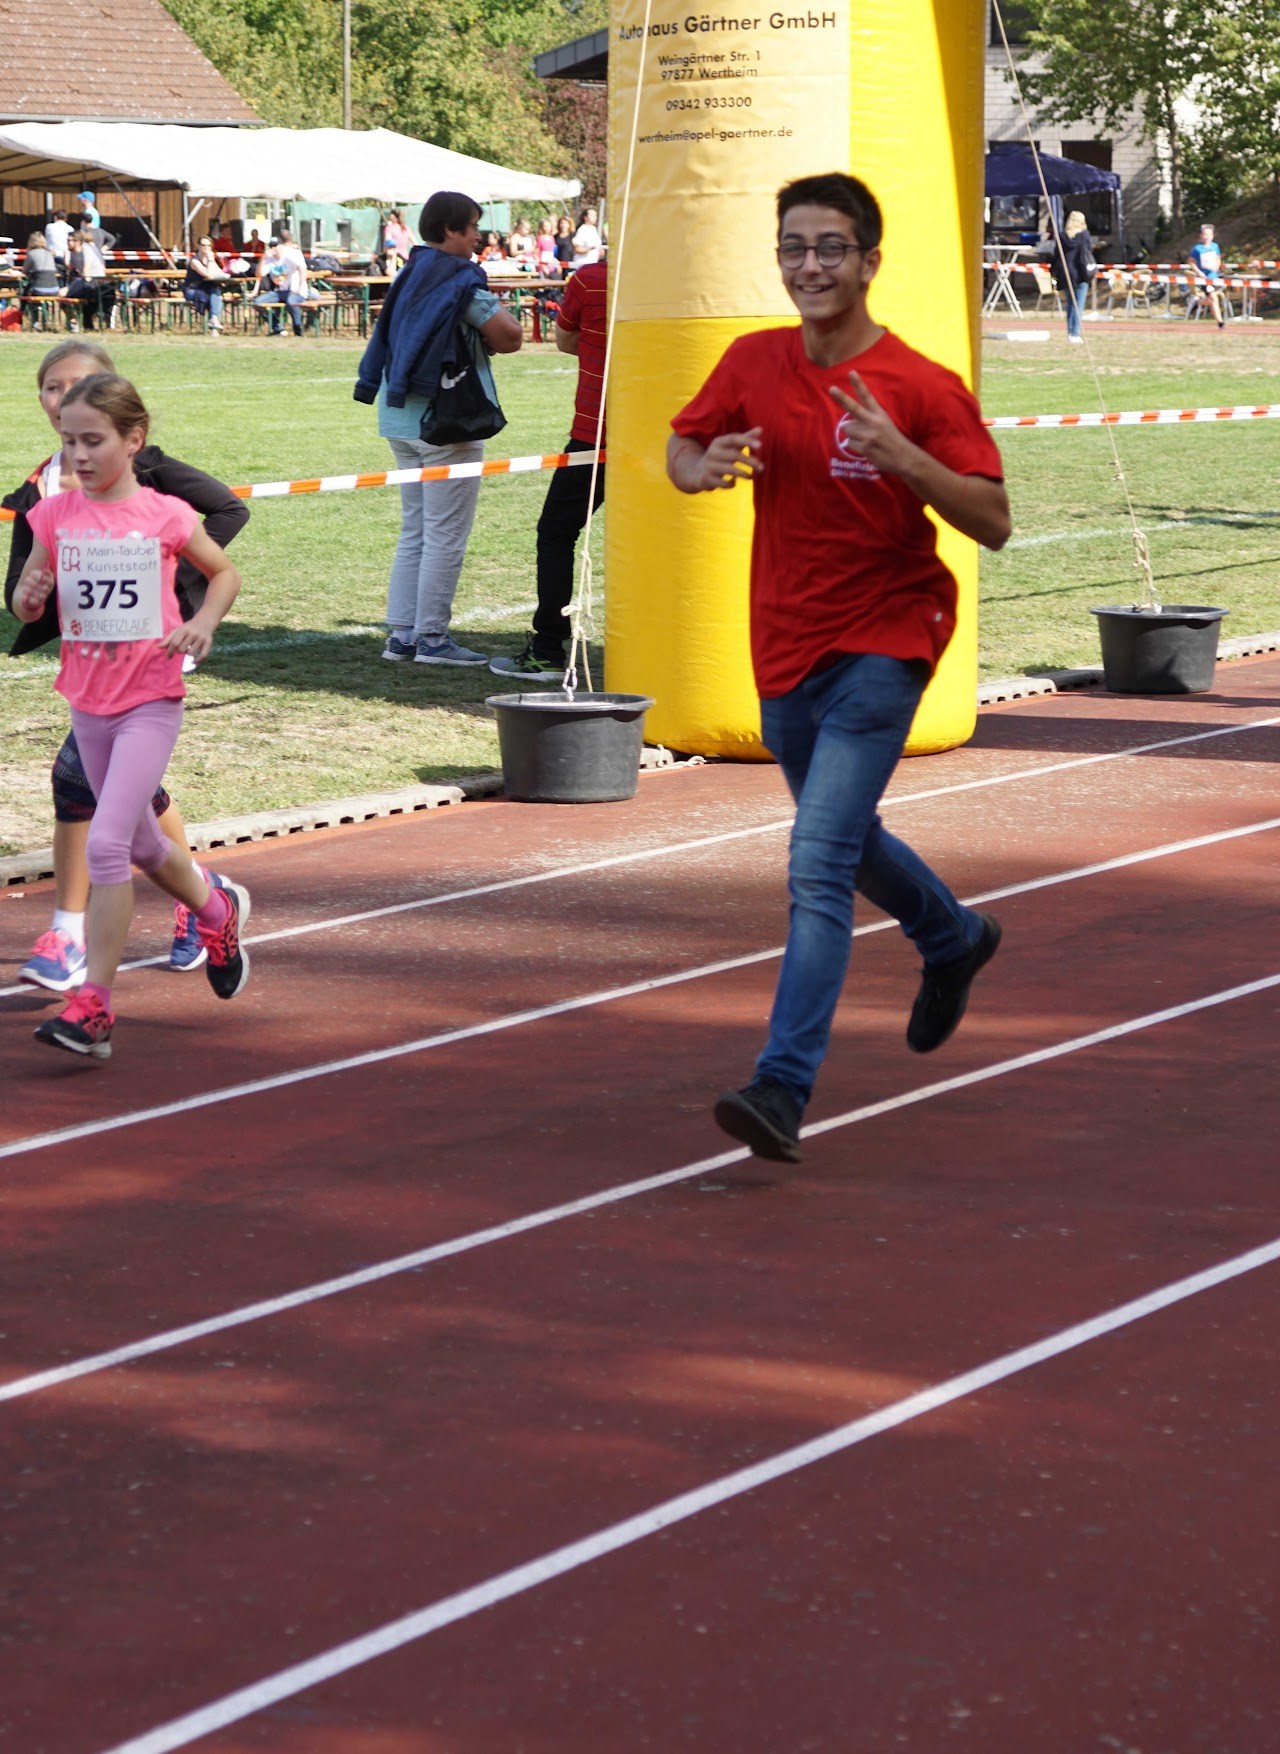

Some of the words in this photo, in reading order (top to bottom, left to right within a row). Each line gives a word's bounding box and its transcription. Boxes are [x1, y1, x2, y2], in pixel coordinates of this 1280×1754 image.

[684, 15, 761, 34] Gärtner
[769, 10, 836, 30] GmbH
[658, 53, 725, 67] Weingärtner
[730, 51, 750, 62] Str.
[756, 50, 761, 61] 1
[661, 69, 694, 81] 97877
[698, 66, 758, 80] Wertheim
[666, 98, 700, 111] 09342
[704, 96, 752, 109] 933300
[638, 126, 793, 144] wertheim@opel-gaertner.de
[86, 560, 157, 573] Kunststoff
[77, 579, 139, 610] 375
